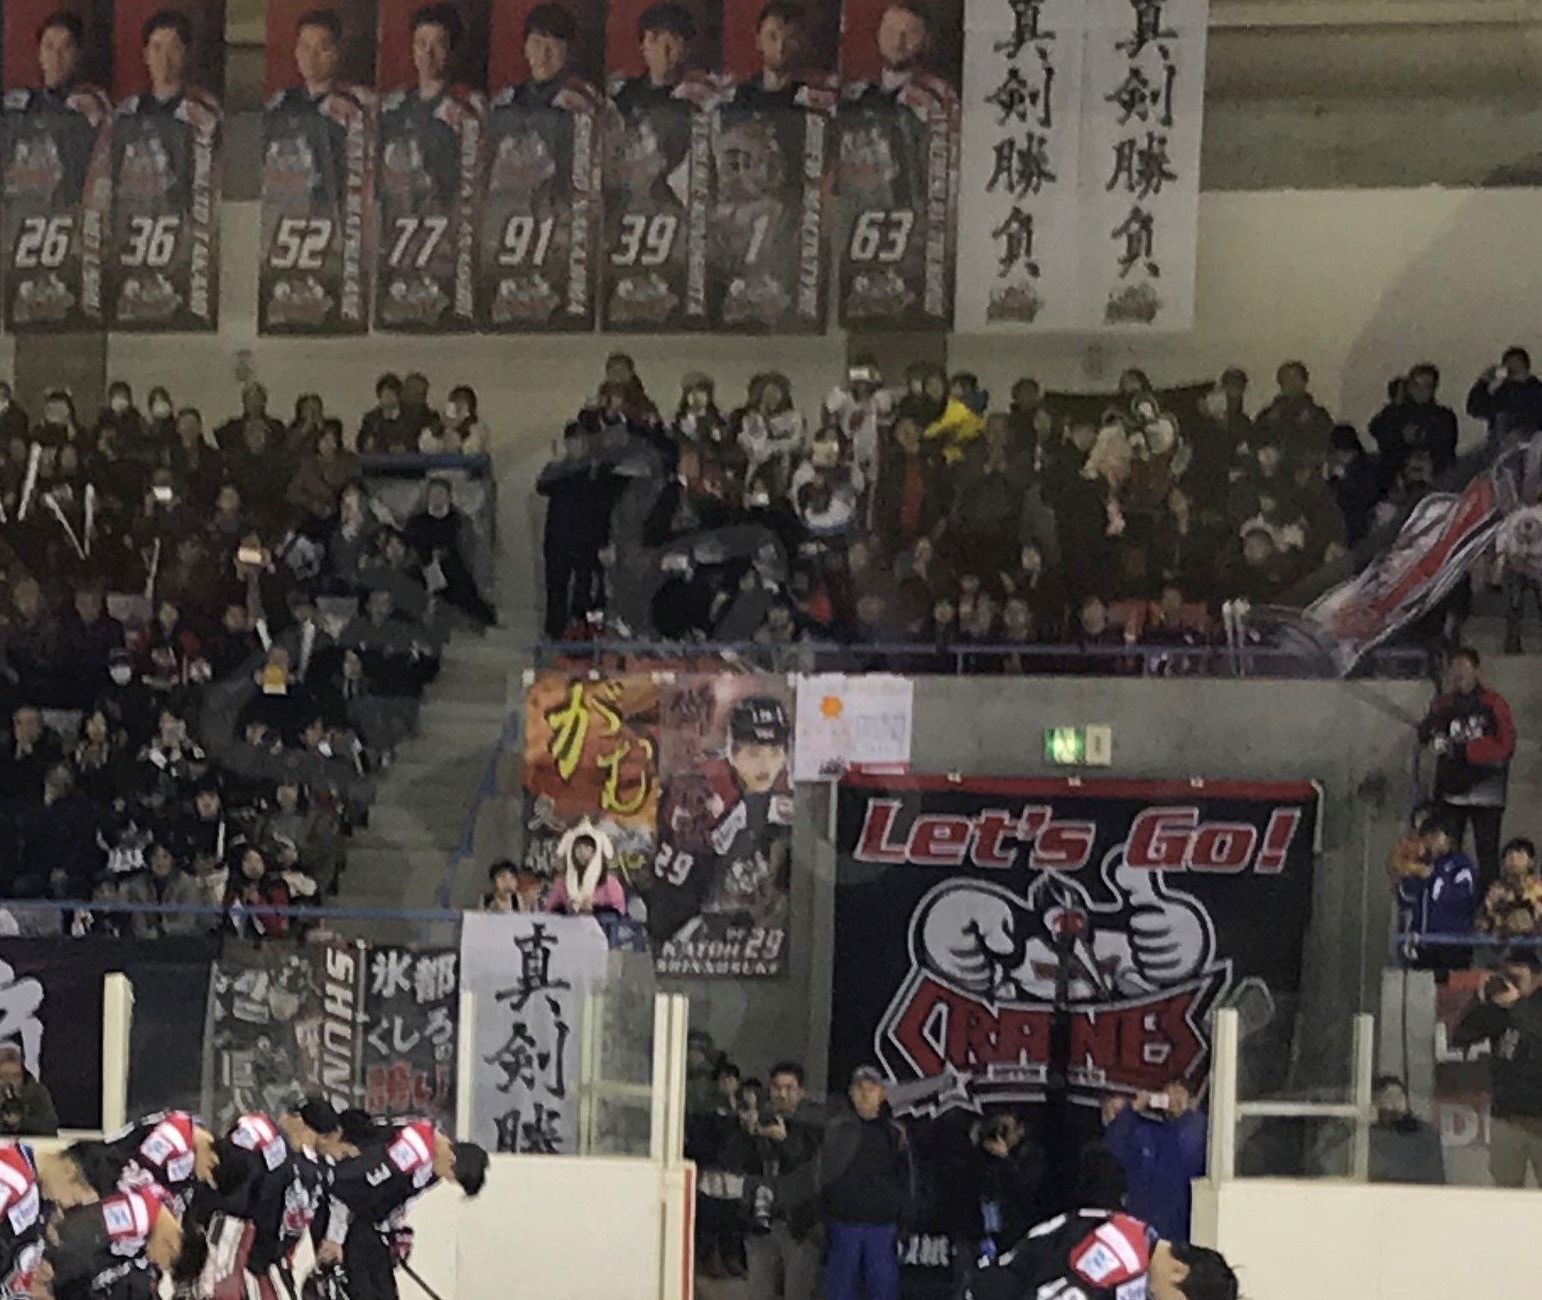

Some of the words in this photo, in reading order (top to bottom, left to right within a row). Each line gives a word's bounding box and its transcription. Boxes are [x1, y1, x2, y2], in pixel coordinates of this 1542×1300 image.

[15, 216, 74, 269] 26
[120, 215, 181, 268] 36
[269, 218, 333, 270] 52
[389, 216, 449, 268] 77
[498, 217, 554, 267] 91
[610, 213, 678, 266] 39
[849, 210, 914, 263] 63
[854, 799, 1096, 869] Let's
[1123, 806, 1301, 874] Go!
[654, 843, 693, 886] 29
[745, 928, 785, 959] 29
[371, 951, 456, 1003] 氷都
